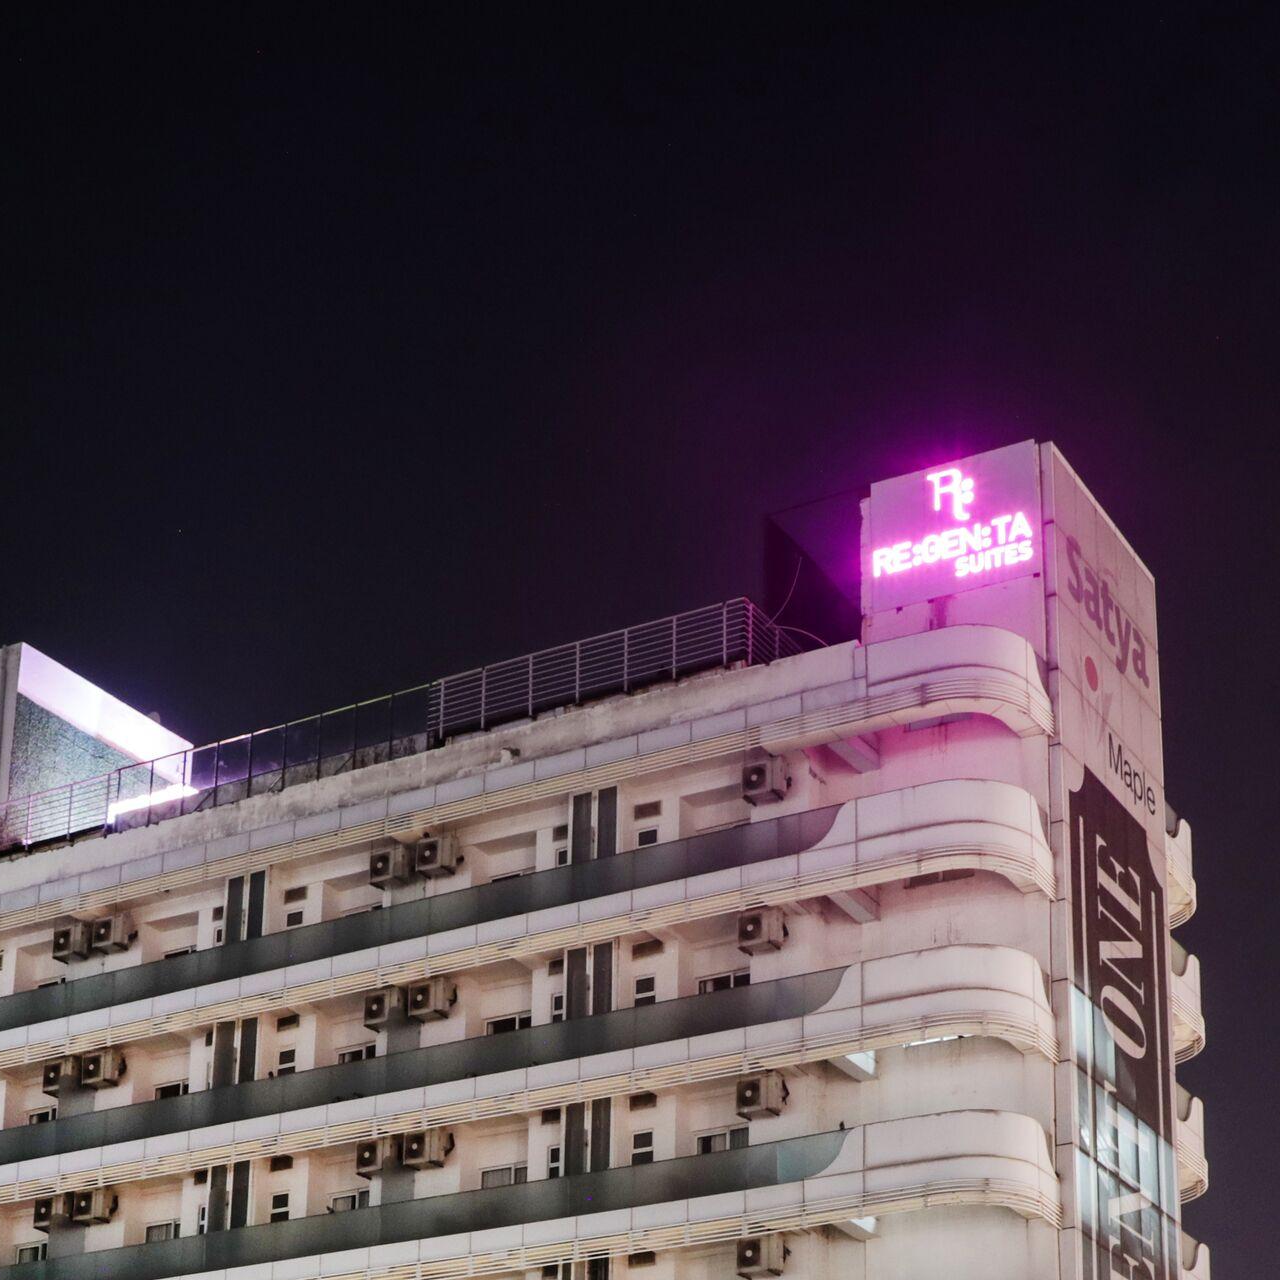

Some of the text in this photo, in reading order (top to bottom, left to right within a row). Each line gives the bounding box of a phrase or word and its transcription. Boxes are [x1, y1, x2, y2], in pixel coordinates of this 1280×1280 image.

[955, 540, 1034, 578] SUITES
[1066, 534, 1150, 690] Satya
[1107, 732, 1156, 816] Maple
[1095, 833, 1148, 1060] ONE
